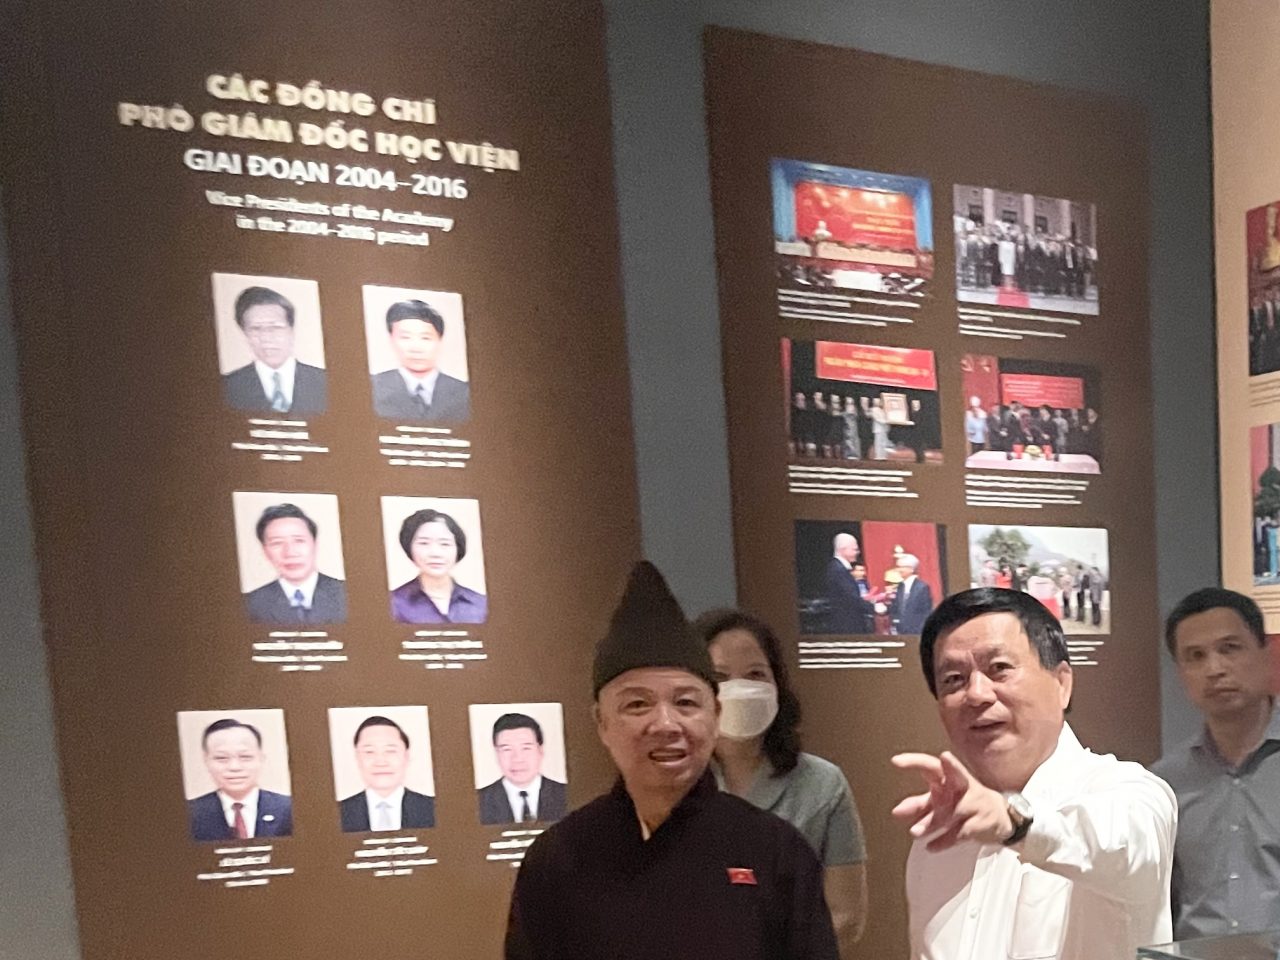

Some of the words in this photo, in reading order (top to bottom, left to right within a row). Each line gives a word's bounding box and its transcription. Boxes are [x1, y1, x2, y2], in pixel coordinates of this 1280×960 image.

[183, 148, 244, 176] GIAI
[246, 155, 331, 186] ĐOẠN
[374, 131, 444, 164] HỌC
[445, 142, 521, 173] VIỆN
